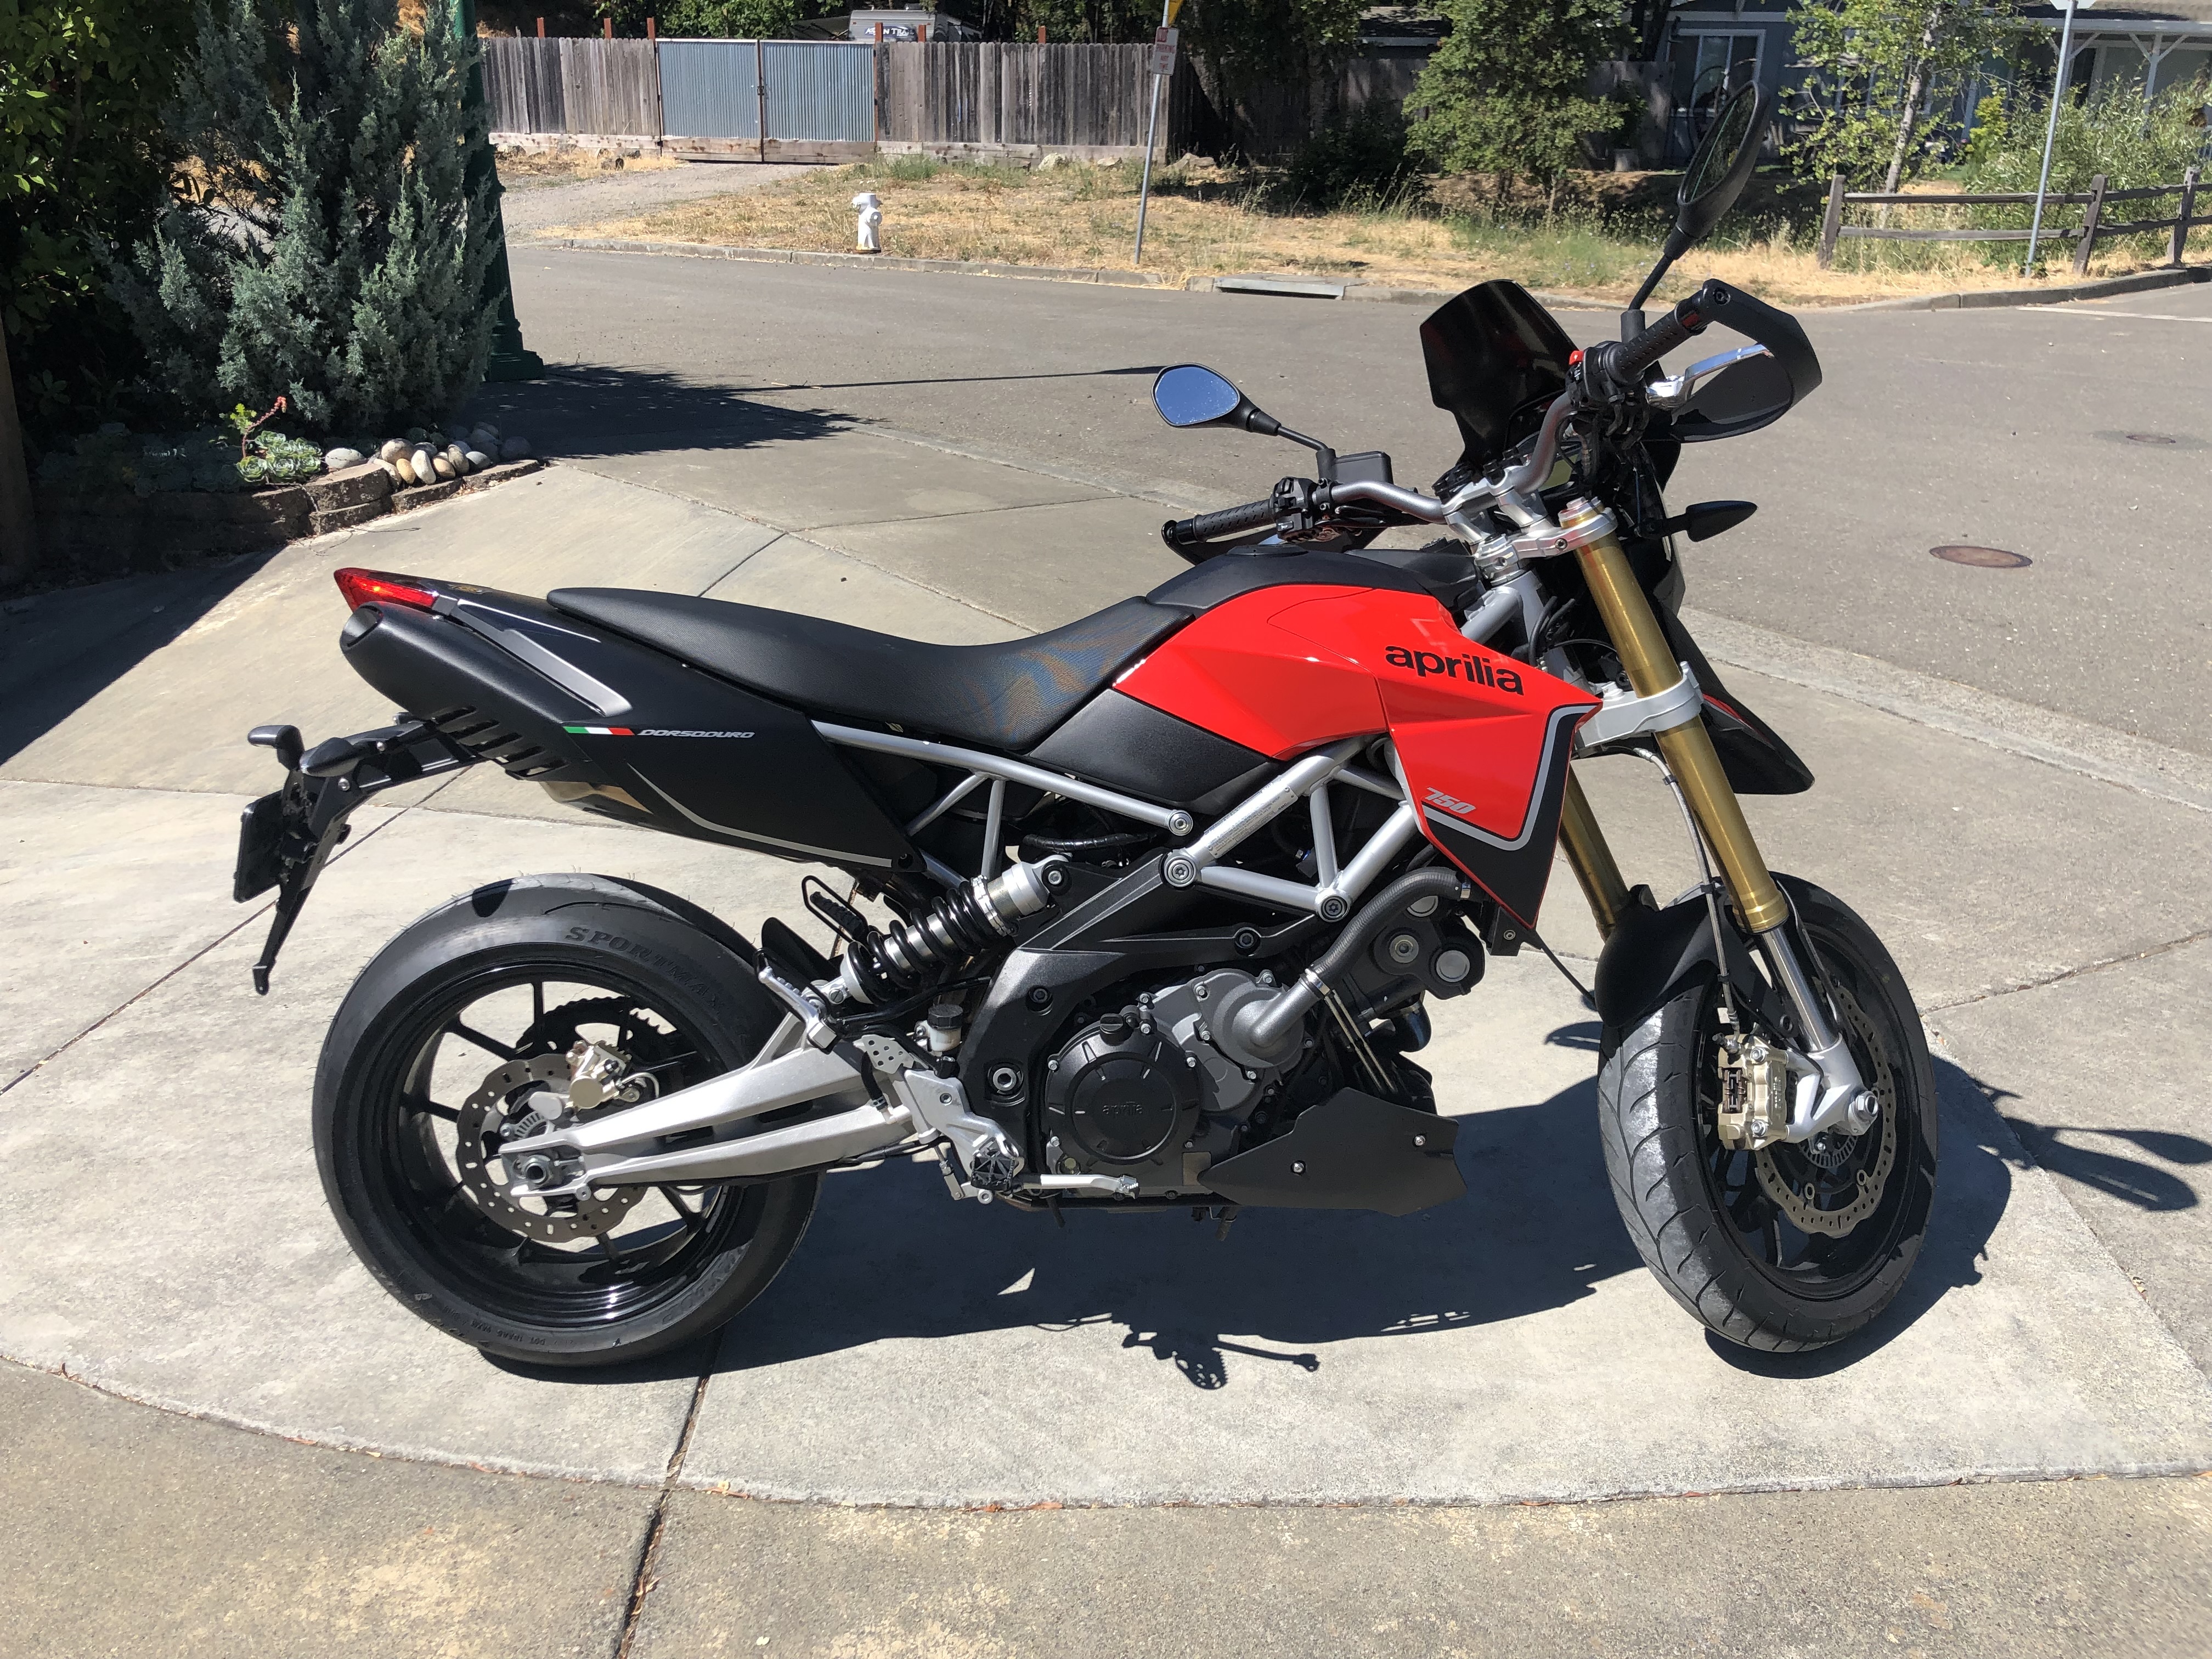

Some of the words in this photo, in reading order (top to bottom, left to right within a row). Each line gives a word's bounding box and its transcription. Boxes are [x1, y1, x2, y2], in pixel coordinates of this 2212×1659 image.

[865, 27, 889, 36] ASN
[1385, 646, 1523, 696] aprilia
[637, 729, 755, 738] DORSODURO
[1425, 787, 1476, 814] 750
